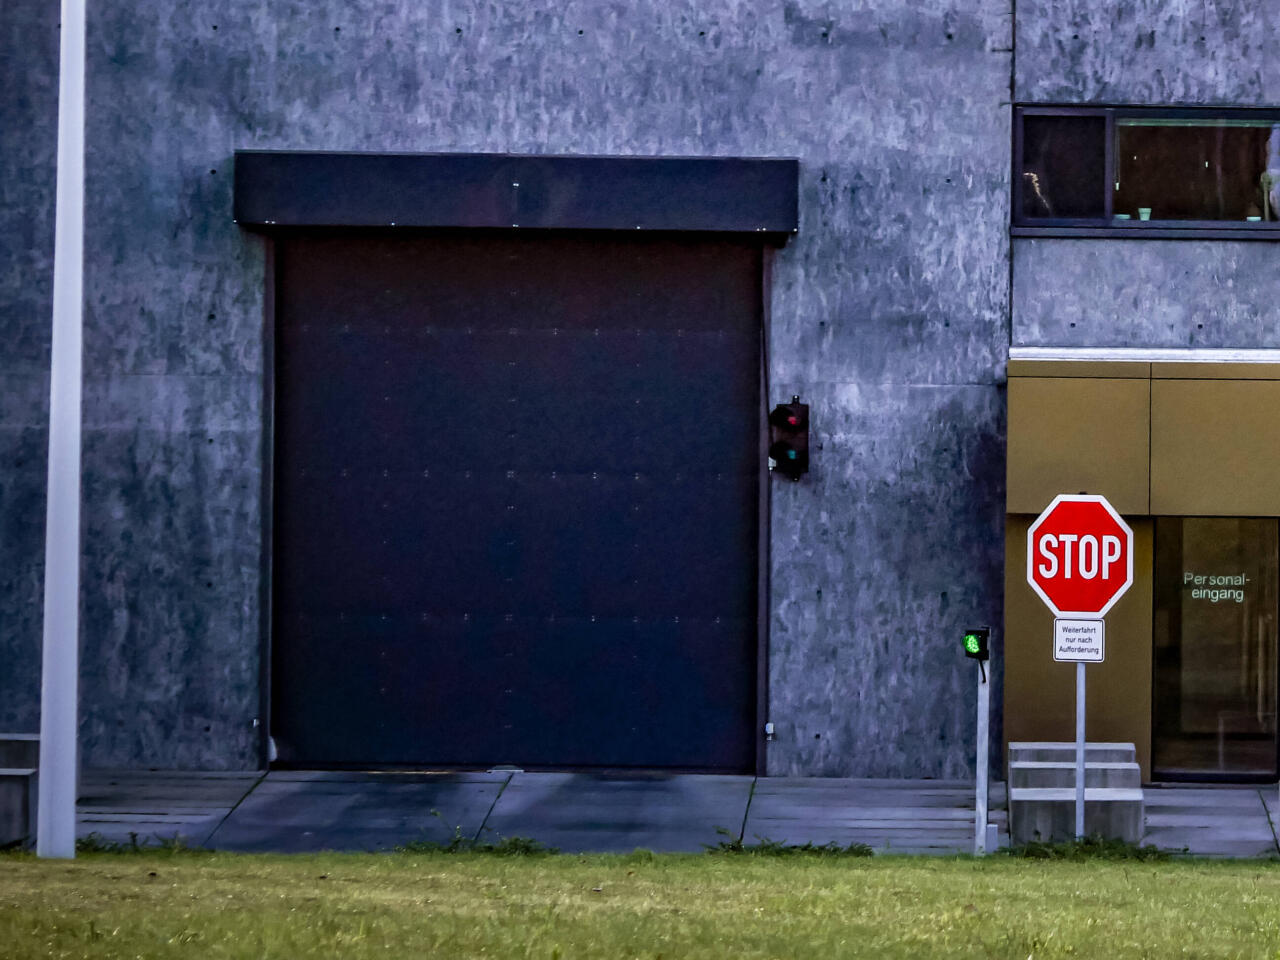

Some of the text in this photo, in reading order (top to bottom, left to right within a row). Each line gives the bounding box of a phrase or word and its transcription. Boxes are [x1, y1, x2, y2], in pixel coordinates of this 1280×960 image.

[1038, 533, 1122, 580] STOP
[1183, 572, 1251, 586] Personal-
[1191, 586, 1245, 603] eingang
